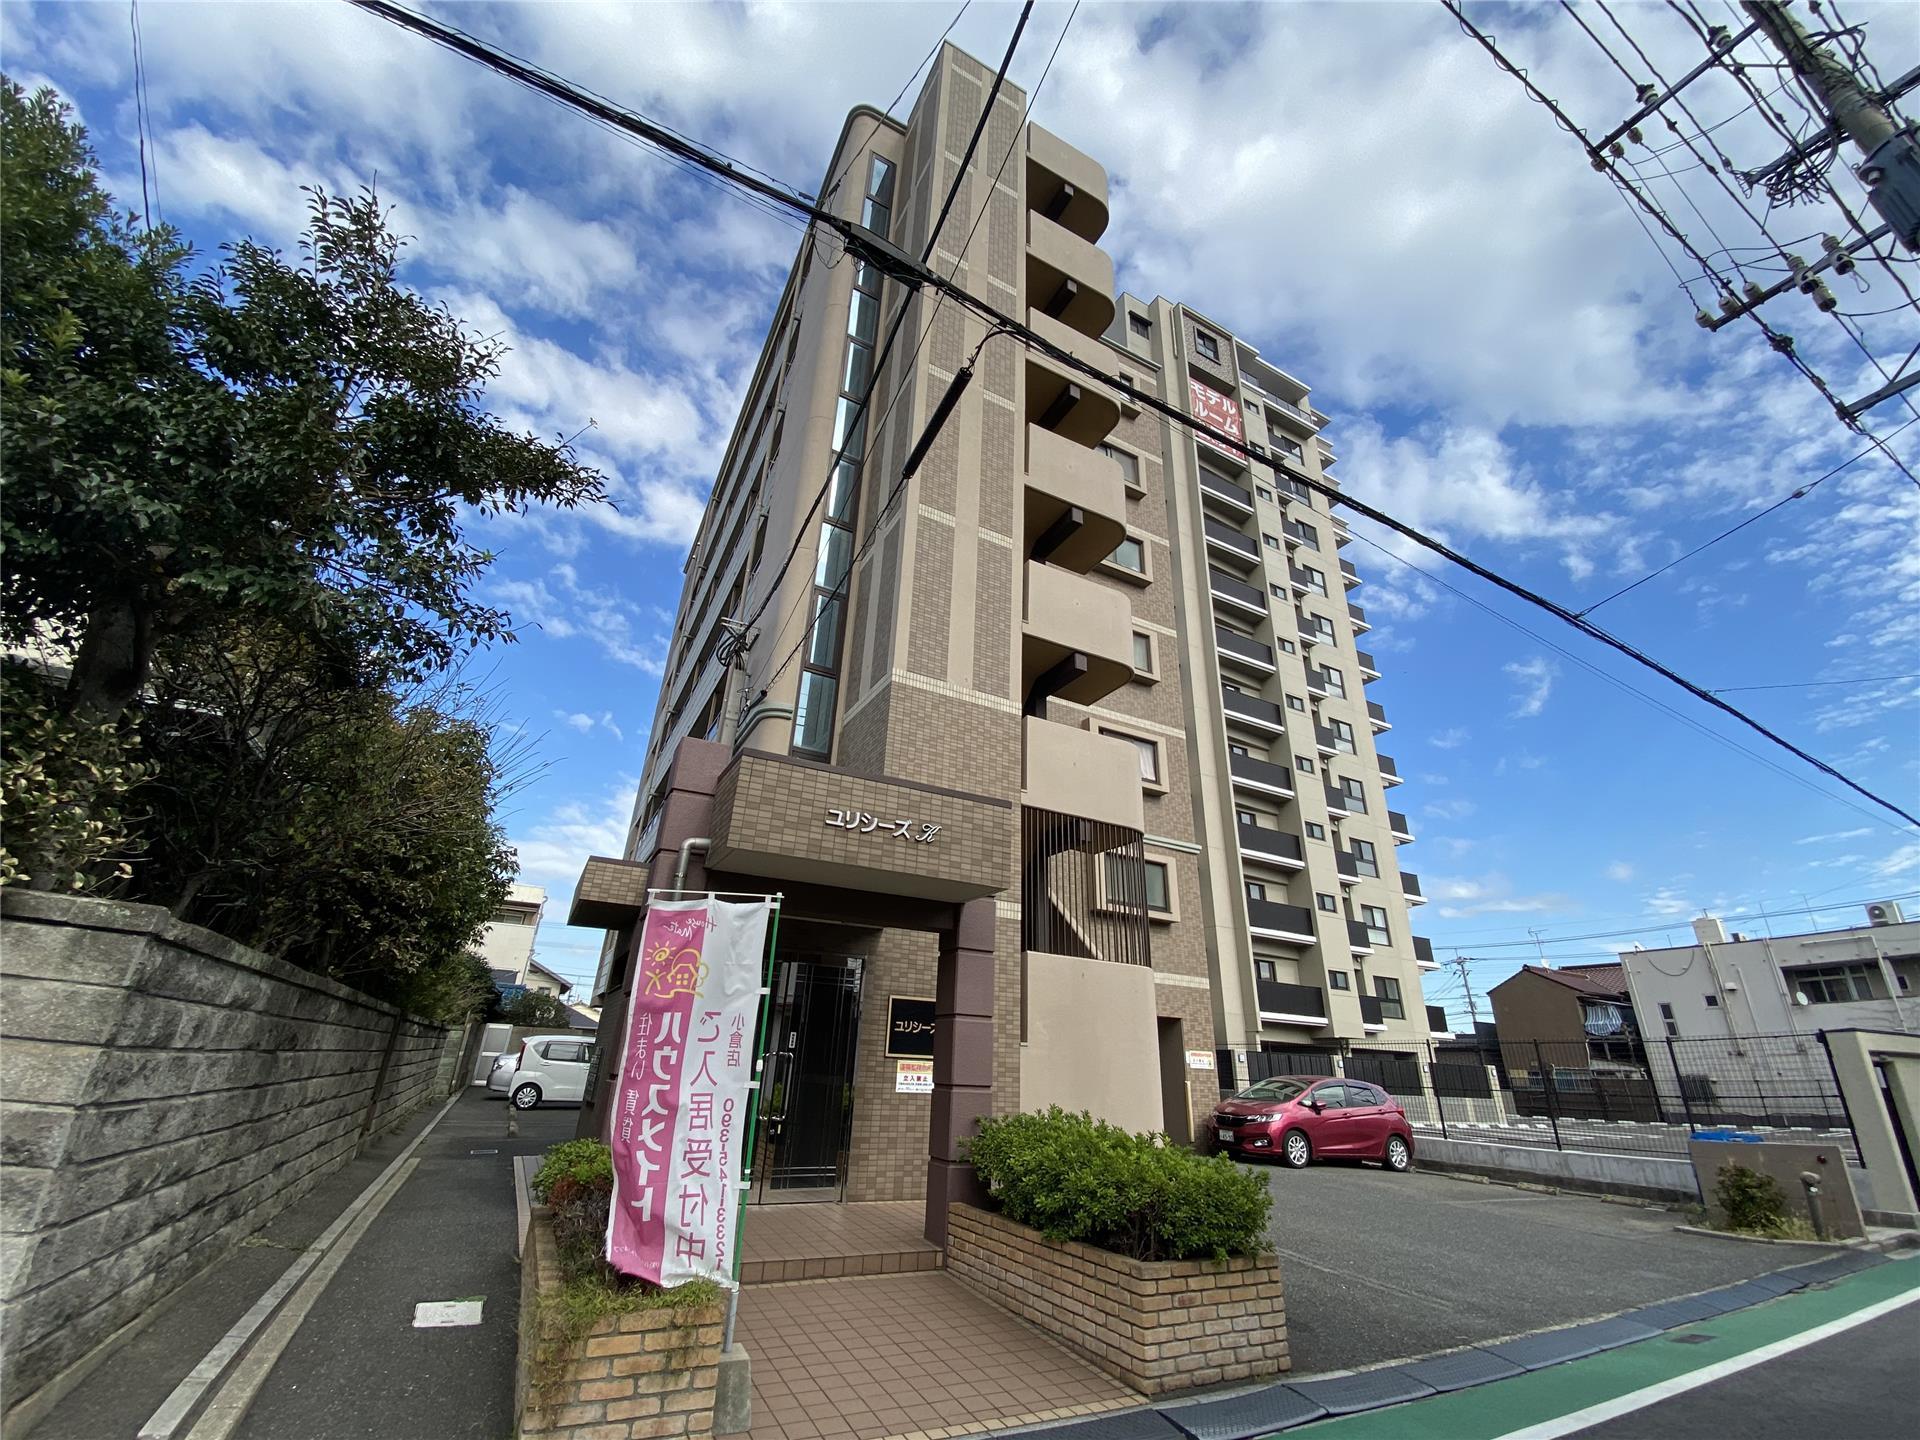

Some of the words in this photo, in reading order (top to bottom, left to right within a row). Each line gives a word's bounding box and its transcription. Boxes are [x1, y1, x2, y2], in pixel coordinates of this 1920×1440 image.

[1190, 380, 1237, 415] モデル
[1194, 399, 1240, 436] ルーム
[825, 809, 912, 839] ユリシーズ
[914, 823, 943, 843] K
